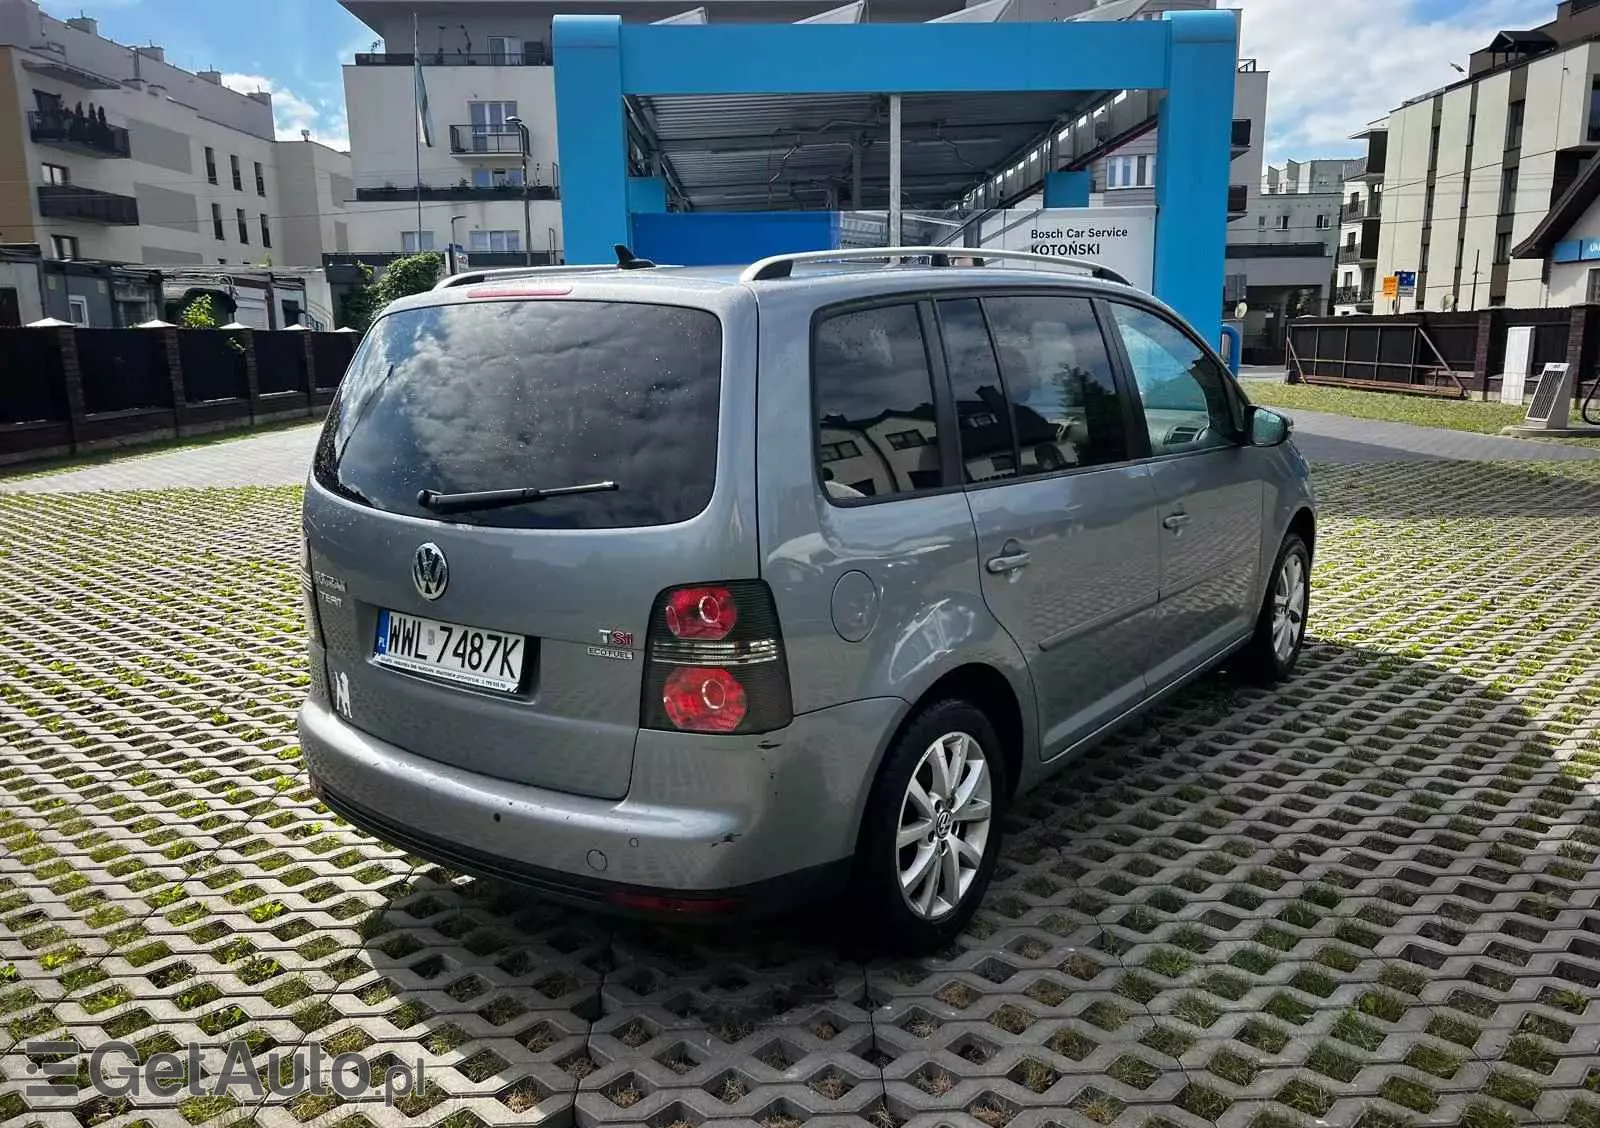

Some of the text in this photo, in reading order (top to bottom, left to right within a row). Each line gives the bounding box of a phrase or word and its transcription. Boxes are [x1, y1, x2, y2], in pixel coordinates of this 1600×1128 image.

[1031, 227, 1128, 239] Bosch Car Service
[1031, 241, 1101, 256] KOTOŃSKI
[598, 629, 633, 647] TSI
[388, 615, 428, 660] WWL
[436, 625, 521, 679] 7487K
[587, 646, 634, 660] ECOFUEL
